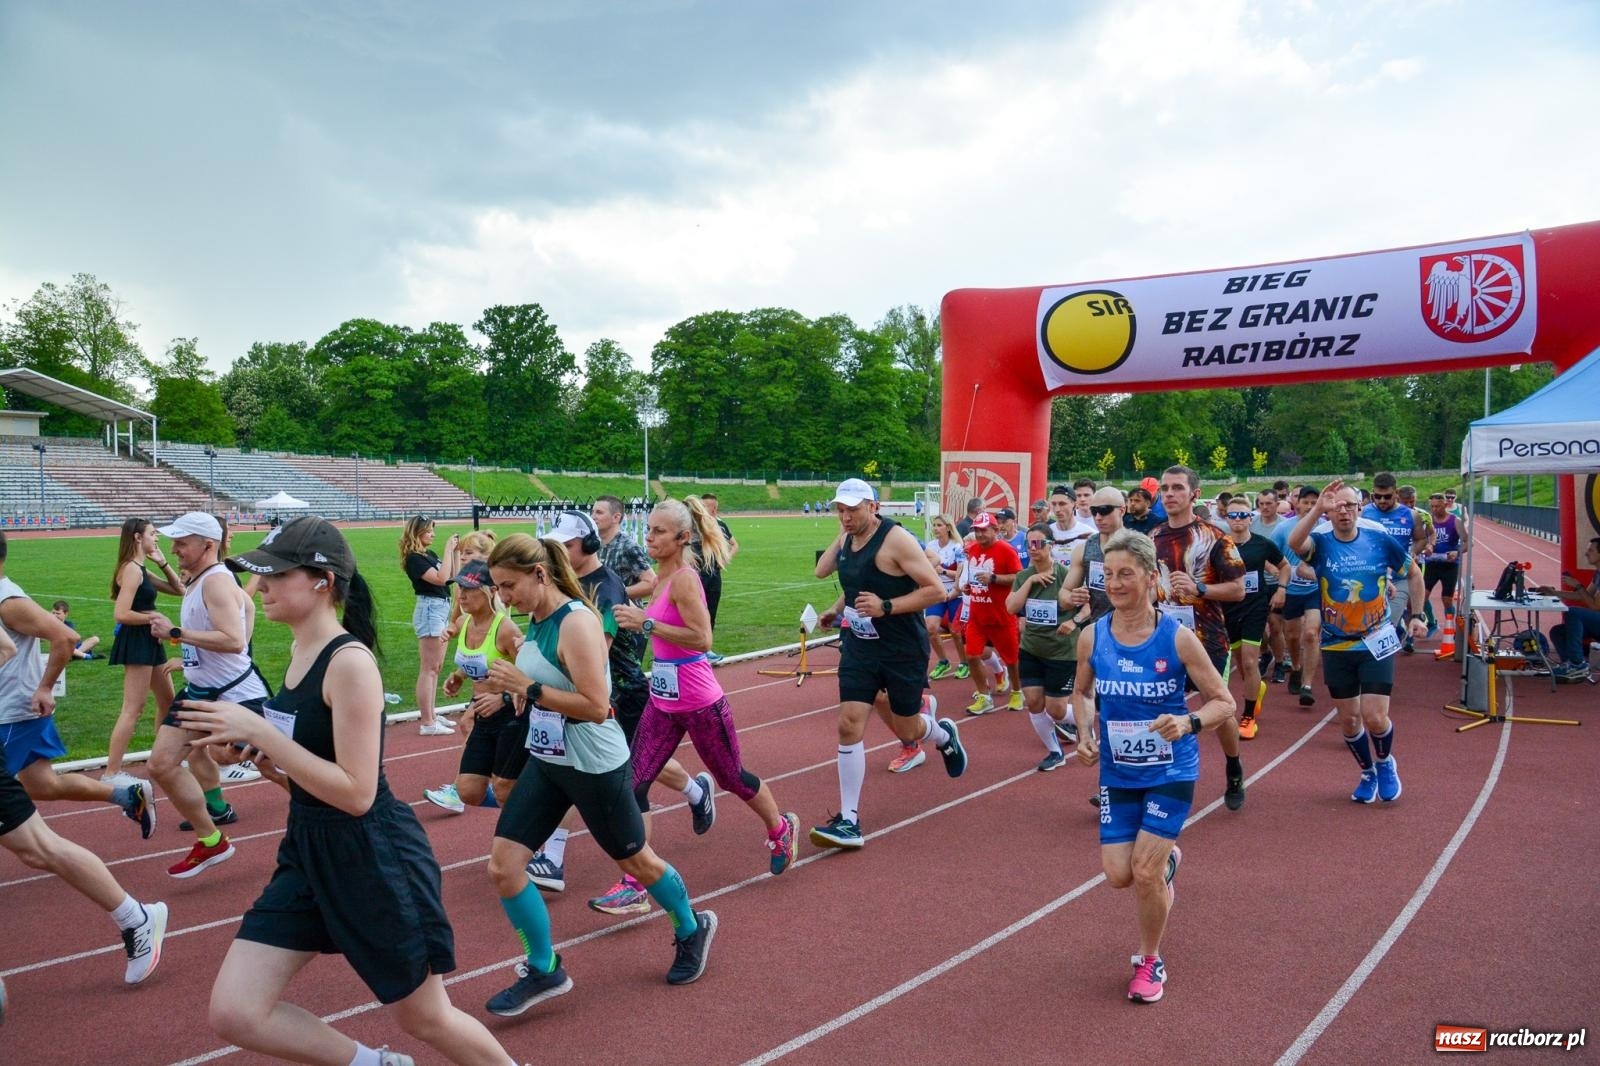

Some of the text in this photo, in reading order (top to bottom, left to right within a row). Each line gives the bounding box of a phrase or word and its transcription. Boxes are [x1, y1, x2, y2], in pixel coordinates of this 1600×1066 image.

[1222, 269, 1312, 295] BIEG
[1086, 296, 1134, 317] SIR
[1161, 292, 1379, 335] BEZ GRANIC
[1181, 331, 1361, 368] RACIBÓRZ
[1032, 609, 1049, 618] 265
[1378, 635, 1395, 649] 270
[462, 664, 478, 676] 157
[531, 727, 549, 745] 188
[1122, 738, 1156, 754] 245
